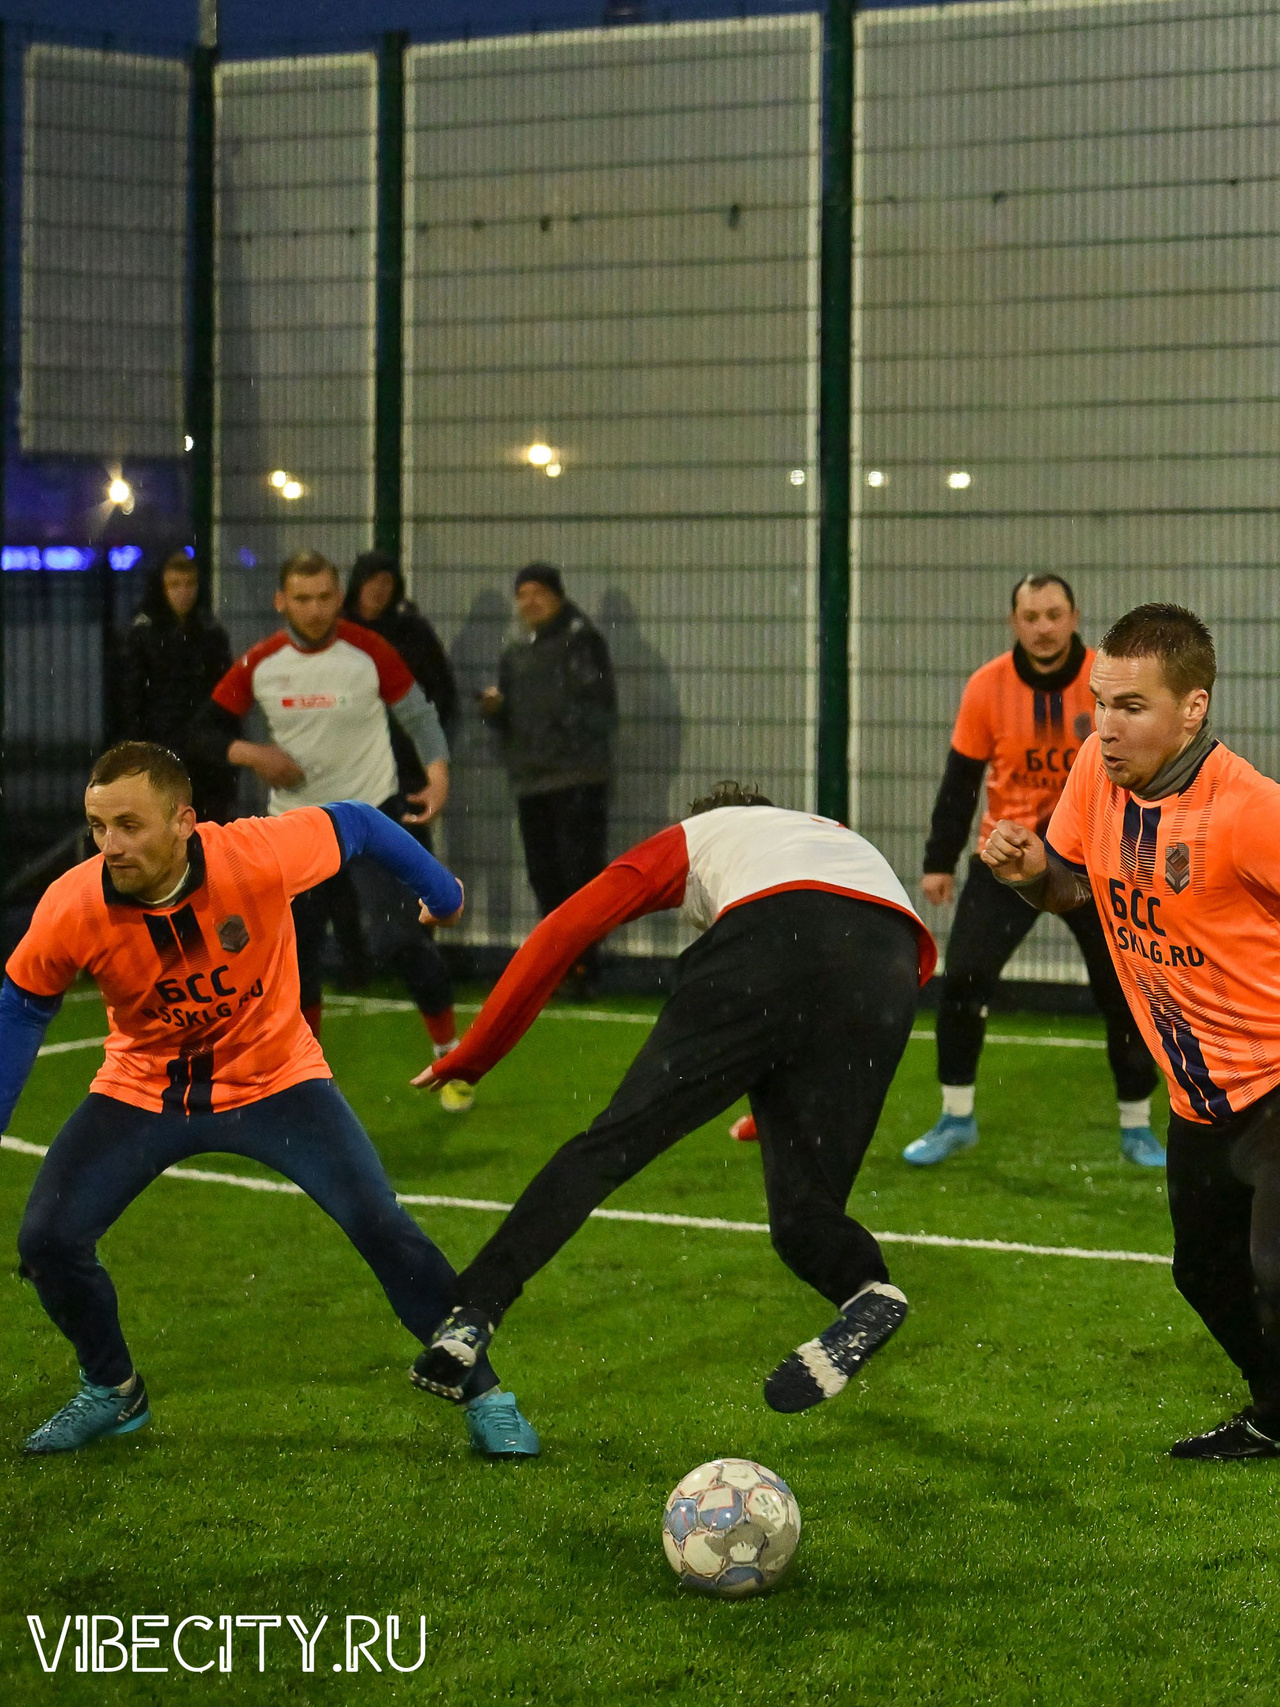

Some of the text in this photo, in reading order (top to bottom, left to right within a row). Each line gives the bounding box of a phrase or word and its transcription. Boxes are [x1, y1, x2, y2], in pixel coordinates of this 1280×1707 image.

[1109, 877, 1167, 937] БСС
[1110, 921, 1205, 967] SKLG.RU
[155, 964, 237, 1003] БСС
